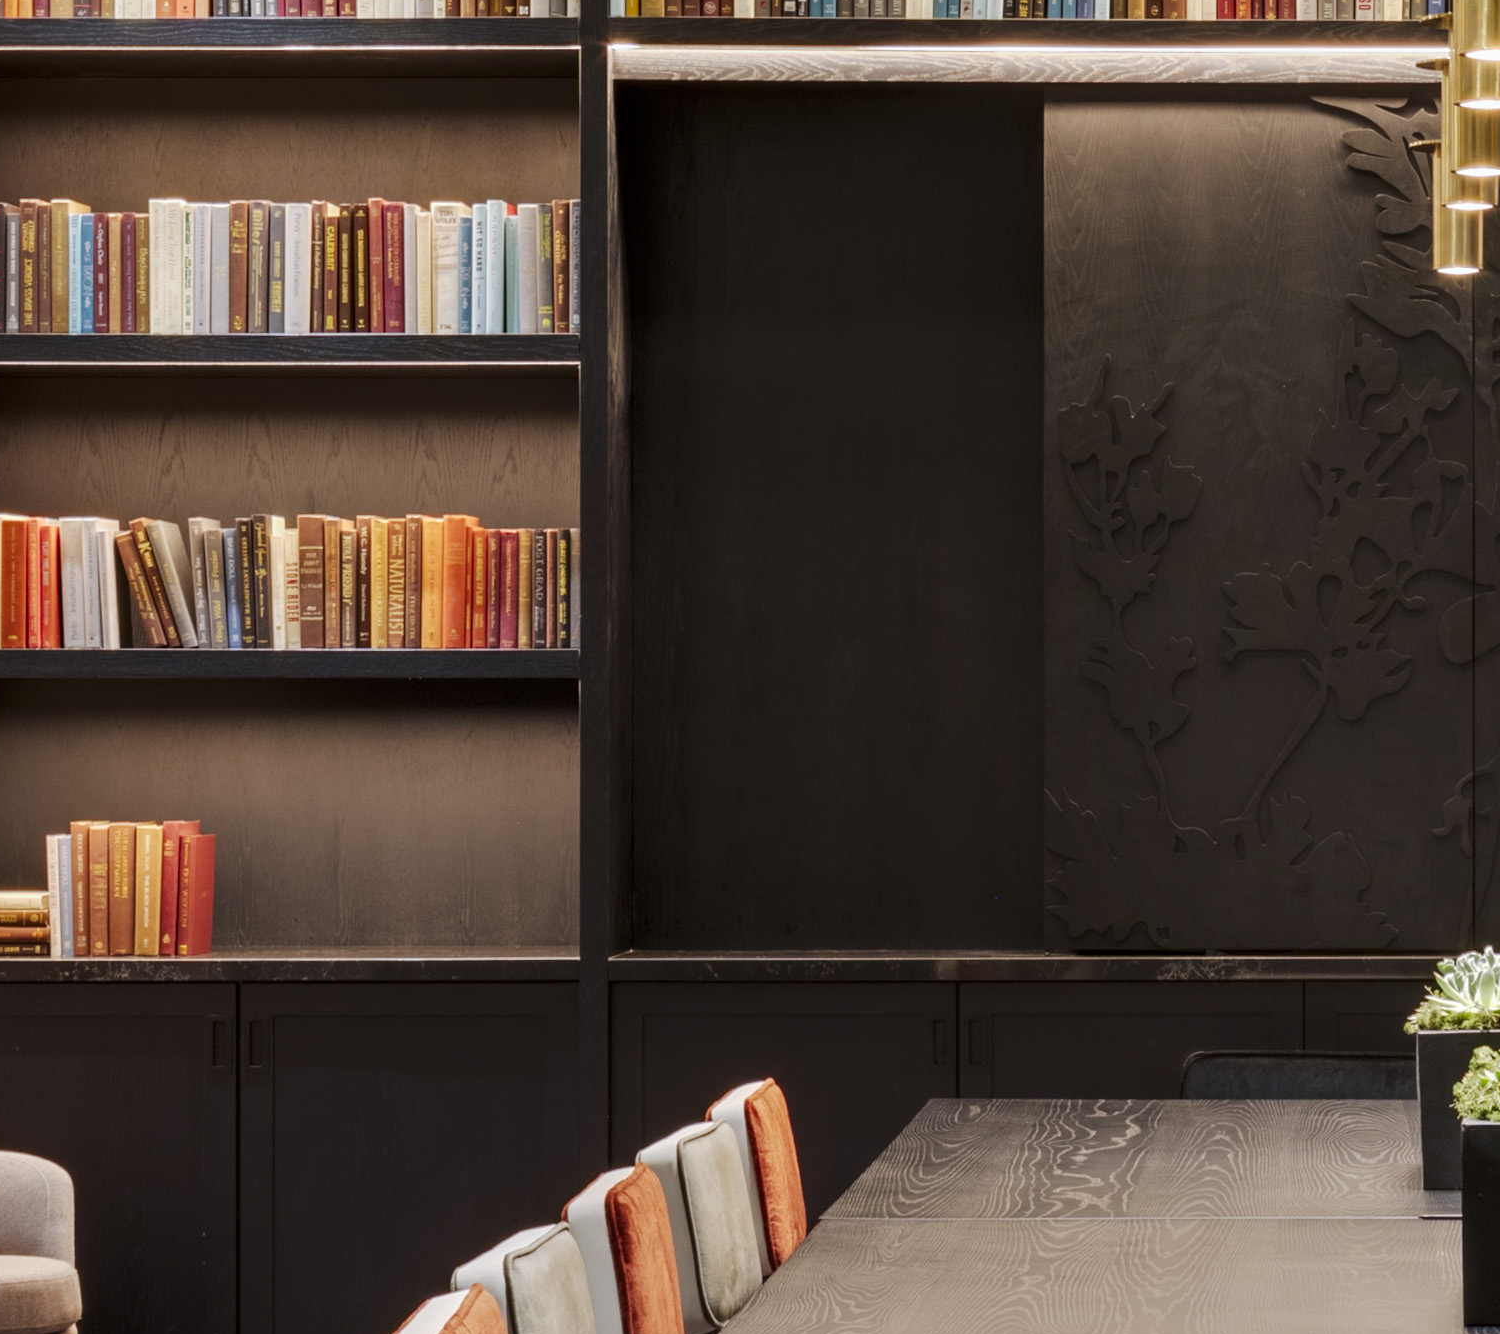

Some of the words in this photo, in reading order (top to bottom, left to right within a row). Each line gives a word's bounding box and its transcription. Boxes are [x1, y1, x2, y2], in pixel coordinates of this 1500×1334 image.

[24, 258, 33, 288] VERDICT
[136, 247, 148, 305] safekeeping
[24, 288, 33, 311] BRASS
[24, 312, 33, 326] THE
[536, 535, 544, 566] POST
[286, 562, 299, 590] STONE
[536, 568, 544, 600] GRAD
[213, 600, 222, 619] Wild
[286, 594, 299, 623] RIDER
[389, 559, 405, 636] NATURALIST
[214, 621, 224, 642] Hogs
